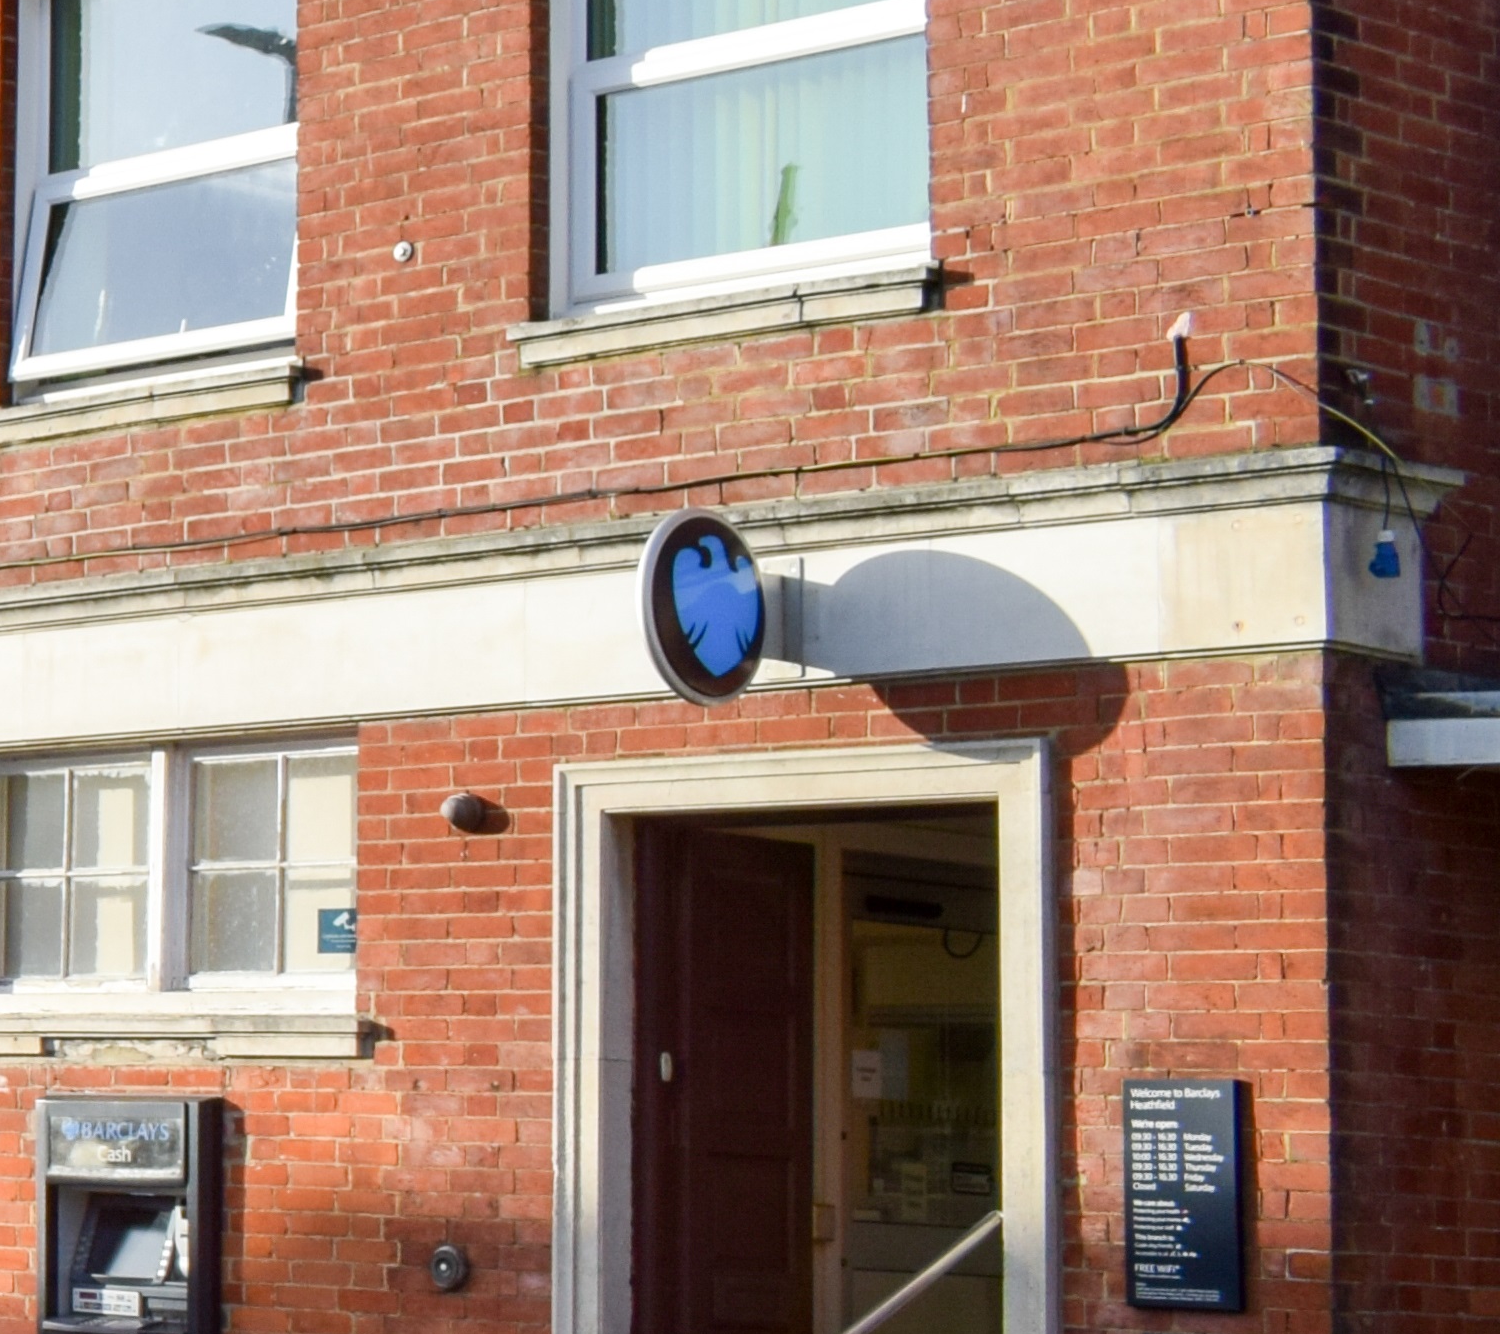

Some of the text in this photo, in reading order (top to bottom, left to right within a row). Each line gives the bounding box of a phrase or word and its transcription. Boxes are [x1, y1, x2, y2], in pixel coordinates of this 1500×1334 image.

[1130, 1087, 1220, 1099] Welcome to Barclays
[1130, 1099, 1175, 1110] Heathfield
[81, 1121, 169, 1141] BARCLAYS
[98, 1146, 131, 1163] Cash
